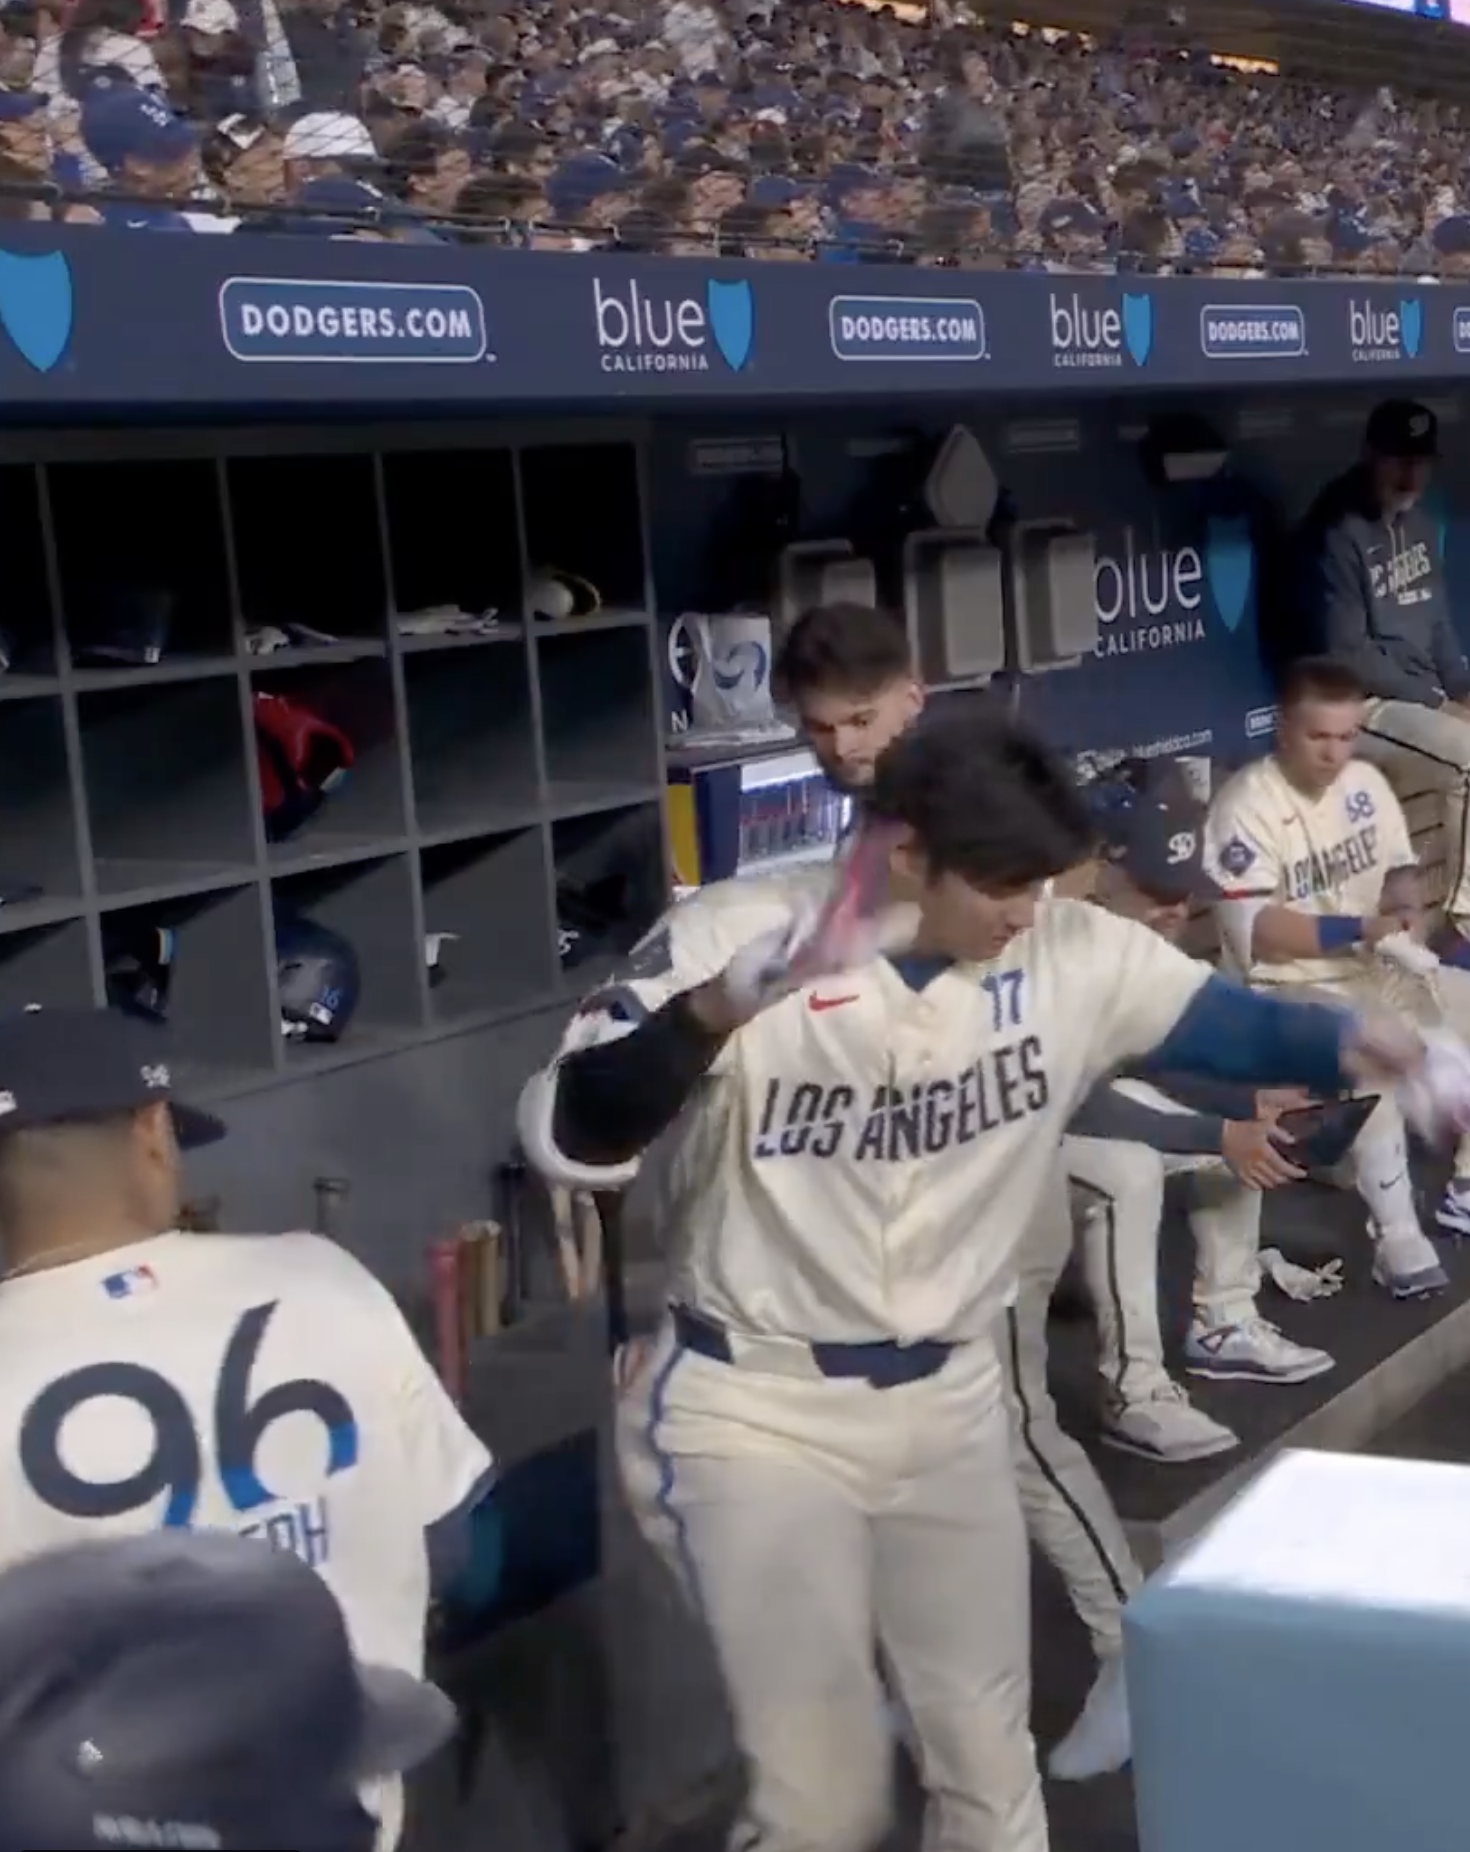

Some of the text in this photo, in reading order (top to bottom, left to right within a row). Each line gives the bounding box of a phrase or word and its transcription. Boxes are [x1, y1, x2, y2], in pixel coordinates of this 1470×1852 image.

[241, 304, 472, 340] DODGERS.COM
[594, 278, 705, 348] blue
[841, 316, 977, 342] DODGERS.COM
[1050, 292, 1121, 349] blue
[1208, 321, 1300, 342] DODGERS.COM
[1350, 299, 1399, 345] blue
[600, 353, 709, 372] CALIFORNIA
[1053, 353, 1122, 367] CALIFORNIA
[1094, 619, 1206, 658] CALIFORNIA
[981, 968, 1025, 1032] 17
[755, 1035, 1051, 1161] LOS ANGELES
[20, 1299, 359, 1529] 96
